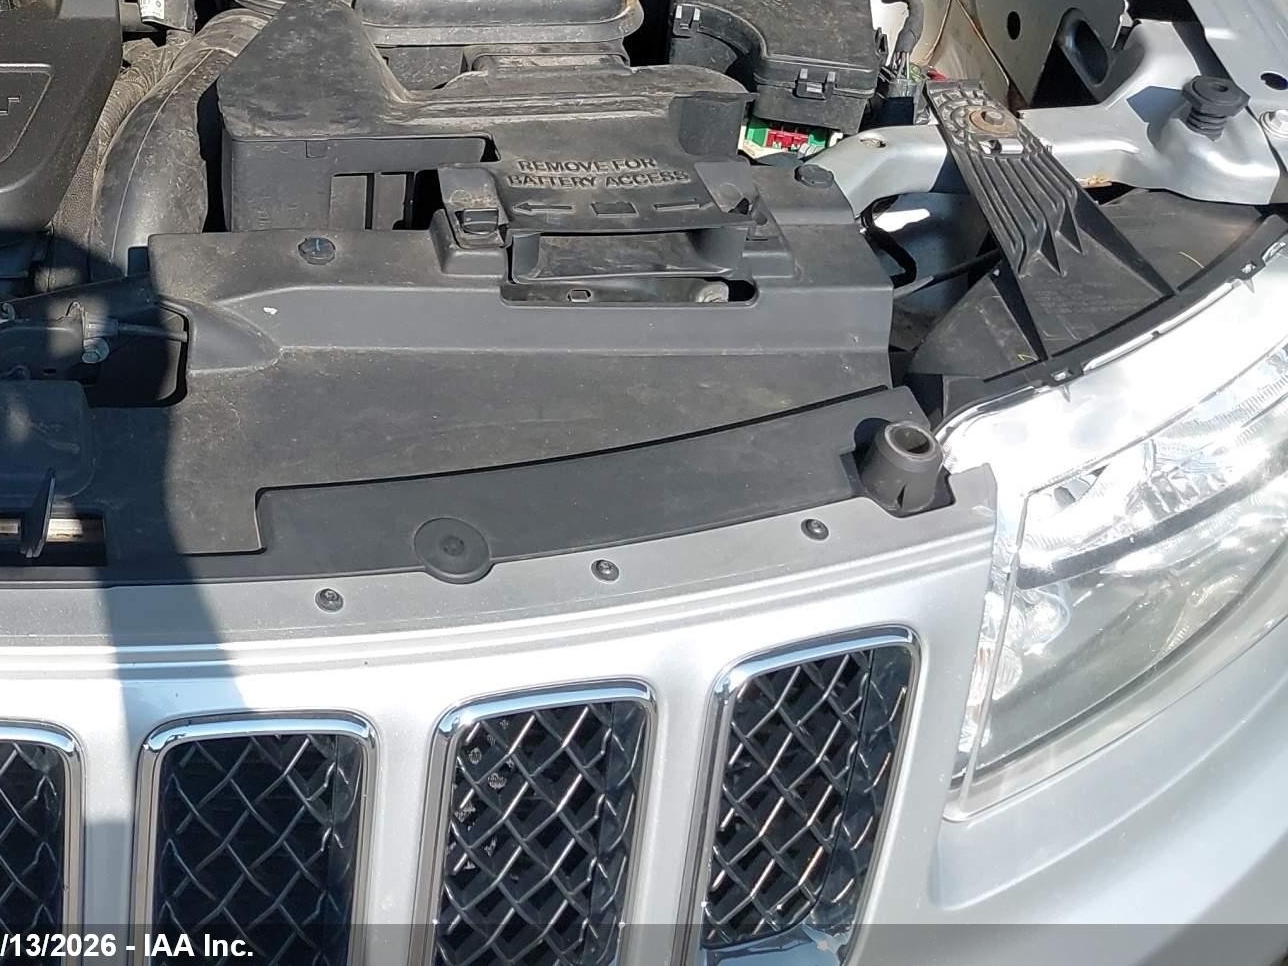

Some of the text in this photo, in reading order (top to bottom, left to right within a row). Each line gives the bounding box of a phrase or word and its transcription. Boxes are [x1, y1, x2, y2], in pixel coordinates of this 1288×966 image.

[517, 158, 657, 173] REMOVE FOR
[508, 169, 689, 188] BATTERY ACCESS
